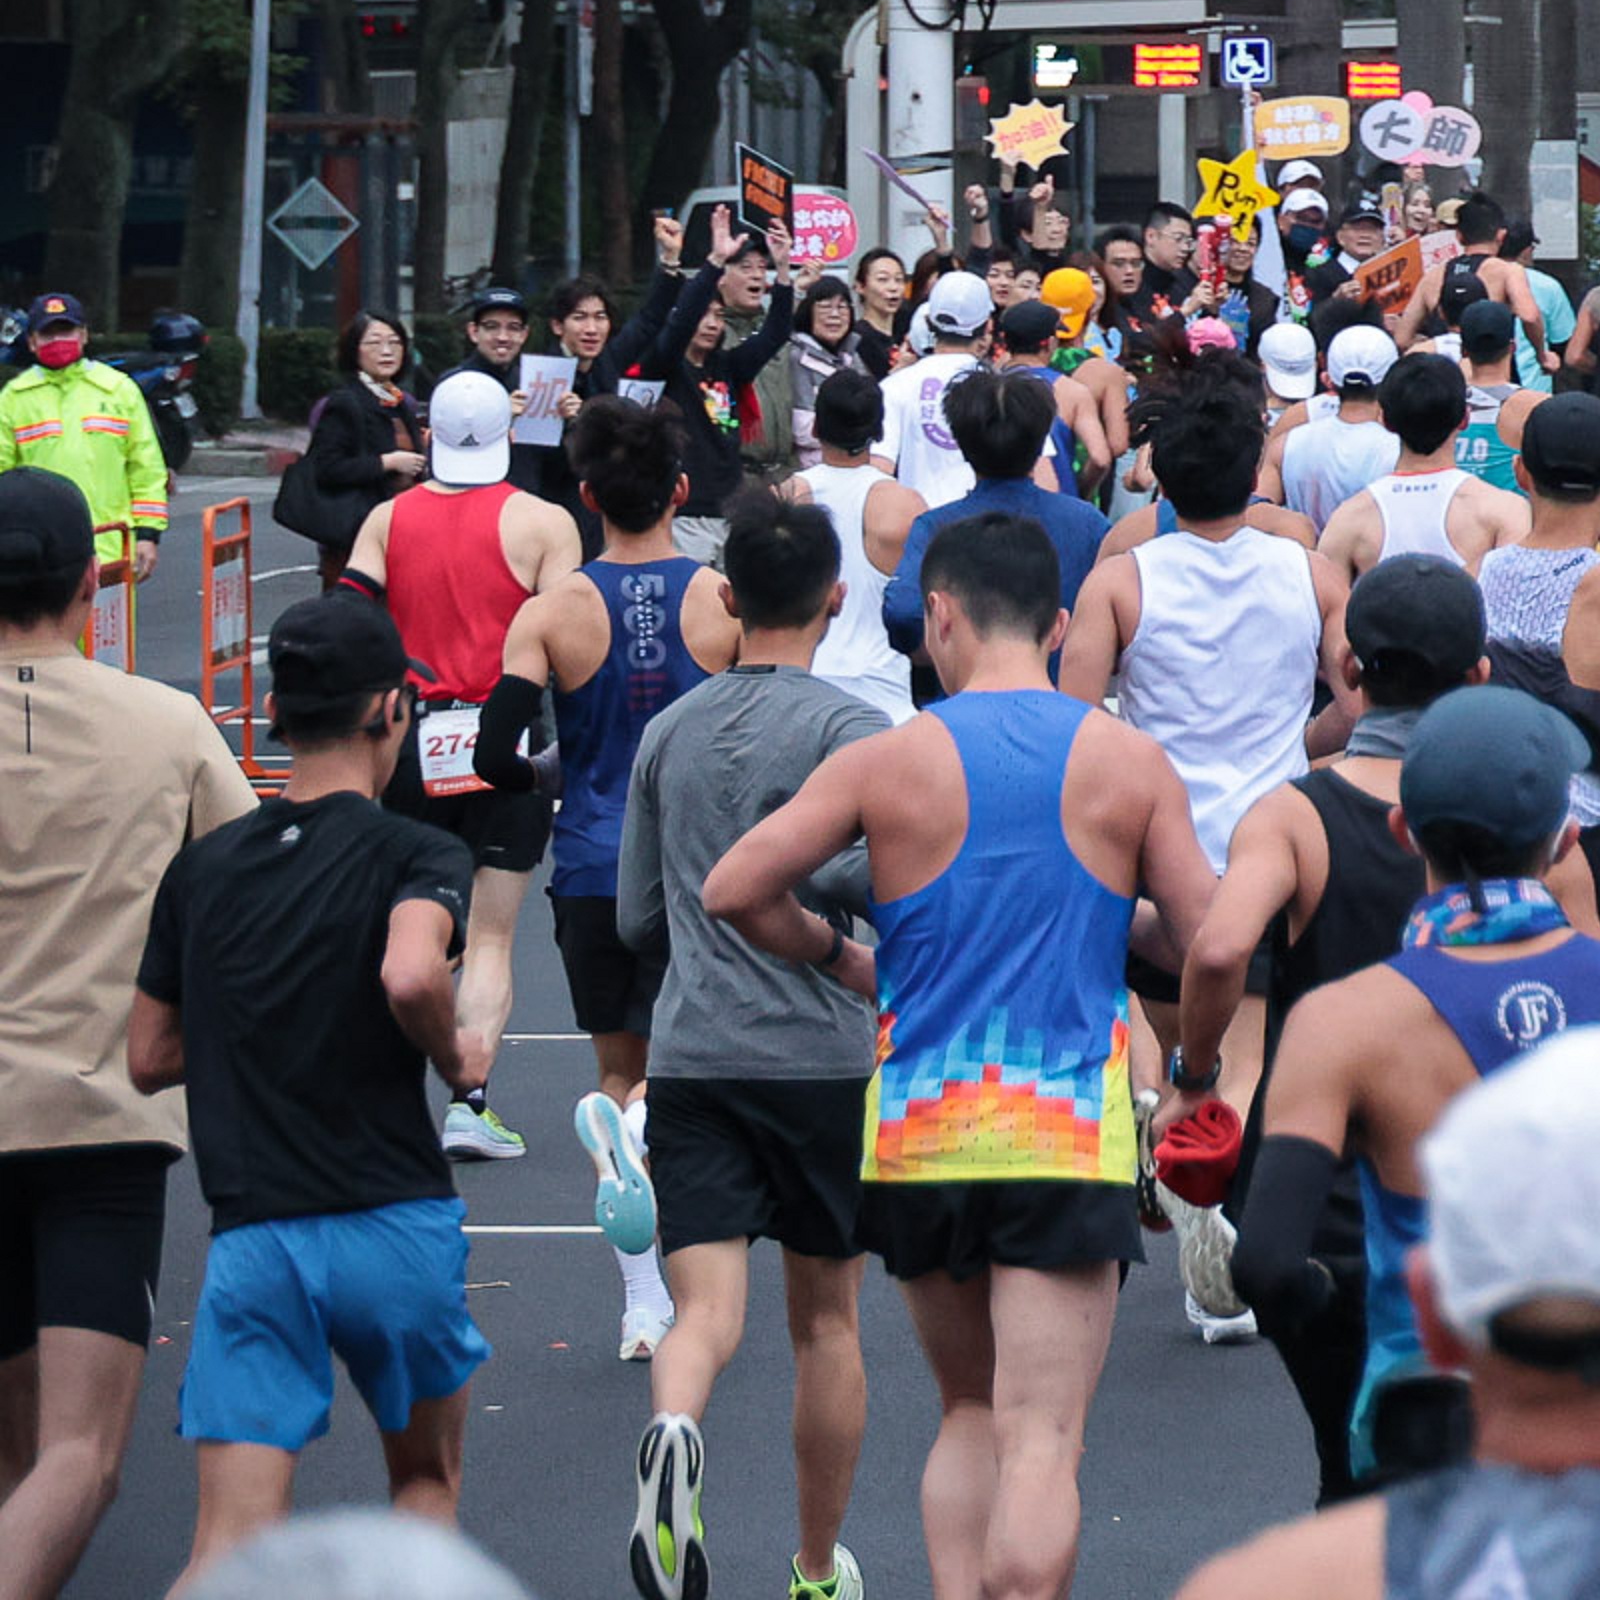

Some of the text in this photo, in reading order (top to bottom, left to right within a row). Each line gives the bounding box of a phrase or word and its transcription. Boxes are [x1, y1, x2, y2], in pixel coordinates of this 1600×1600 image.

[1372, 110, 1472, 157] 大師
[1365, 257, 1408, 291] KEEP
[524, 372, 568, 419] 加
[1552, 553, 1586, 577] soar
[611, 573, 666, 669] 500
